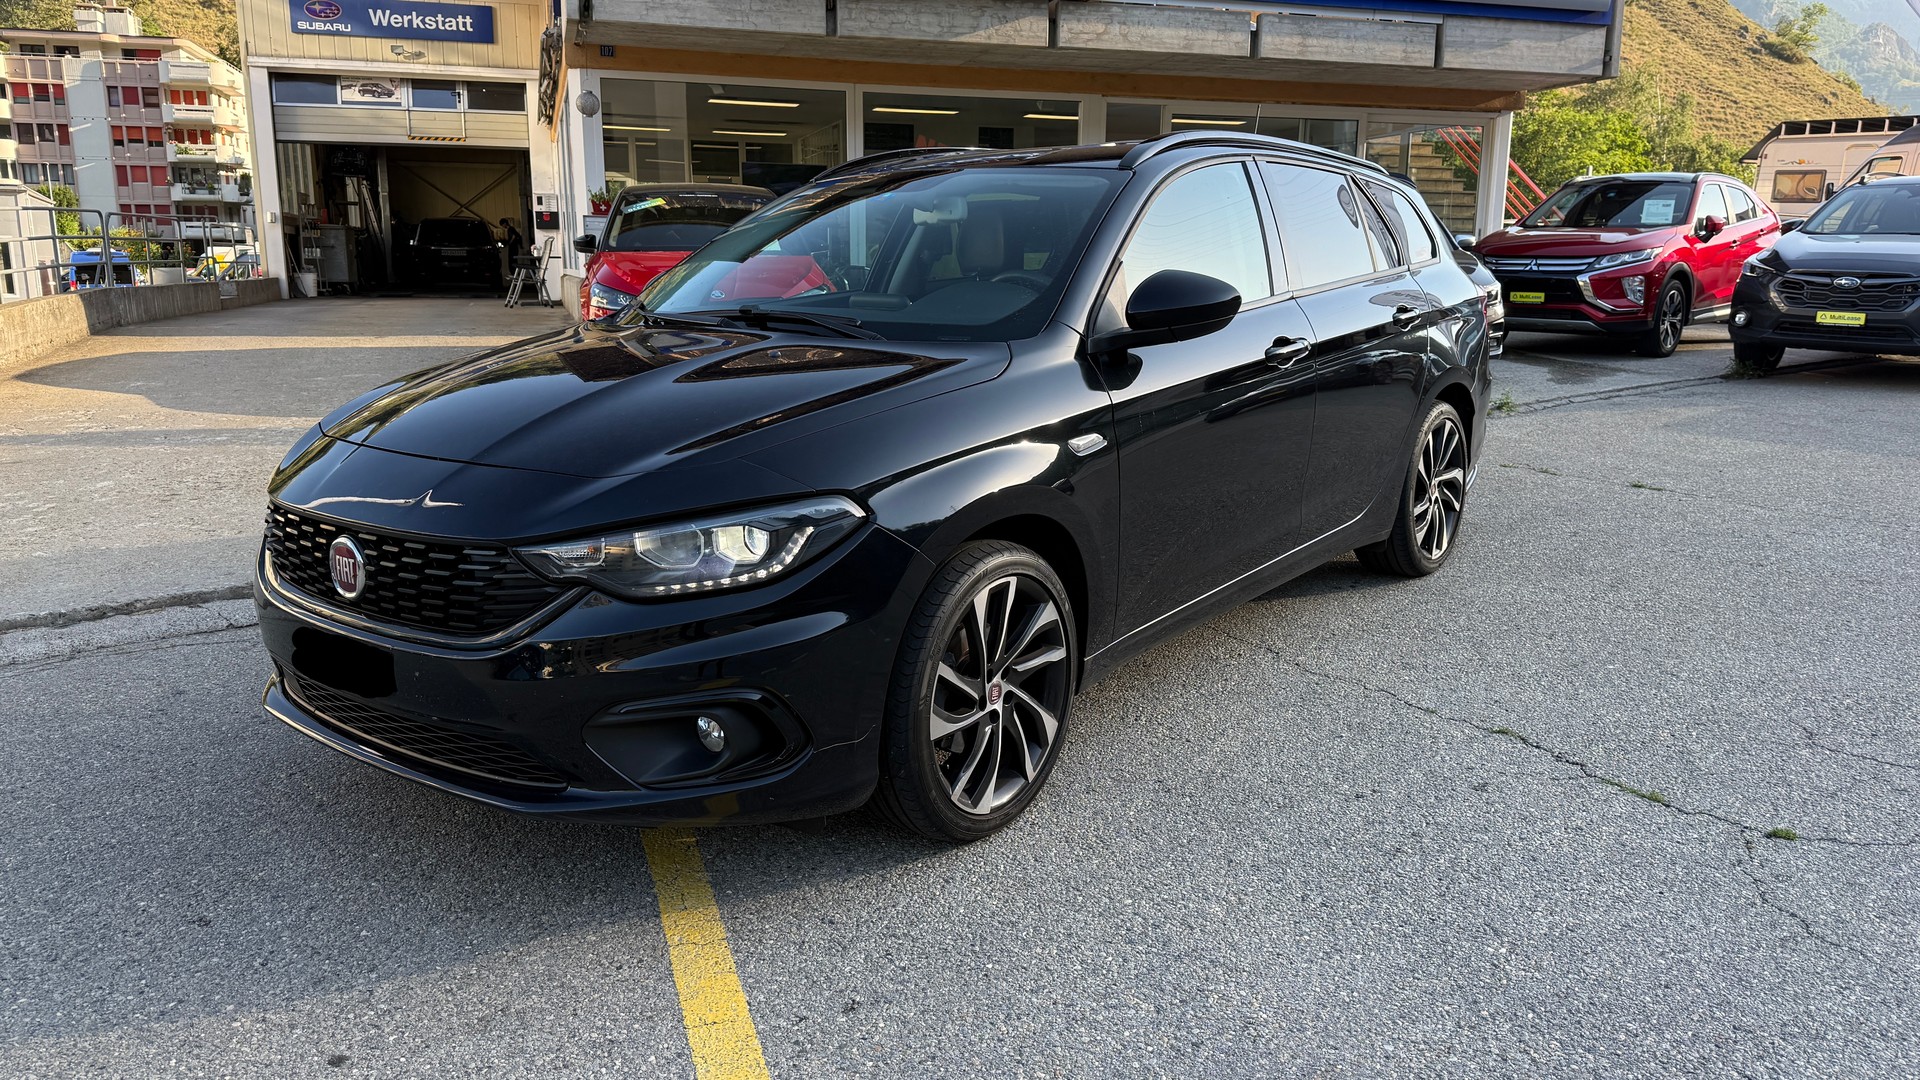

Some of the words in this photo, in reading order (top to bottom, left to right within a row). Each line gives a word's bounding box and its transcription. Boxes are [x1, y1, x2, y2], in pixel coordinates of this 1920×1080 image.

[297, 21, 351, 32] SUBARU
[368, 8, 474, 32] Werkstatt
[601, 46, 613, 56] 107
[335, 554, 355, 584] FIAT
